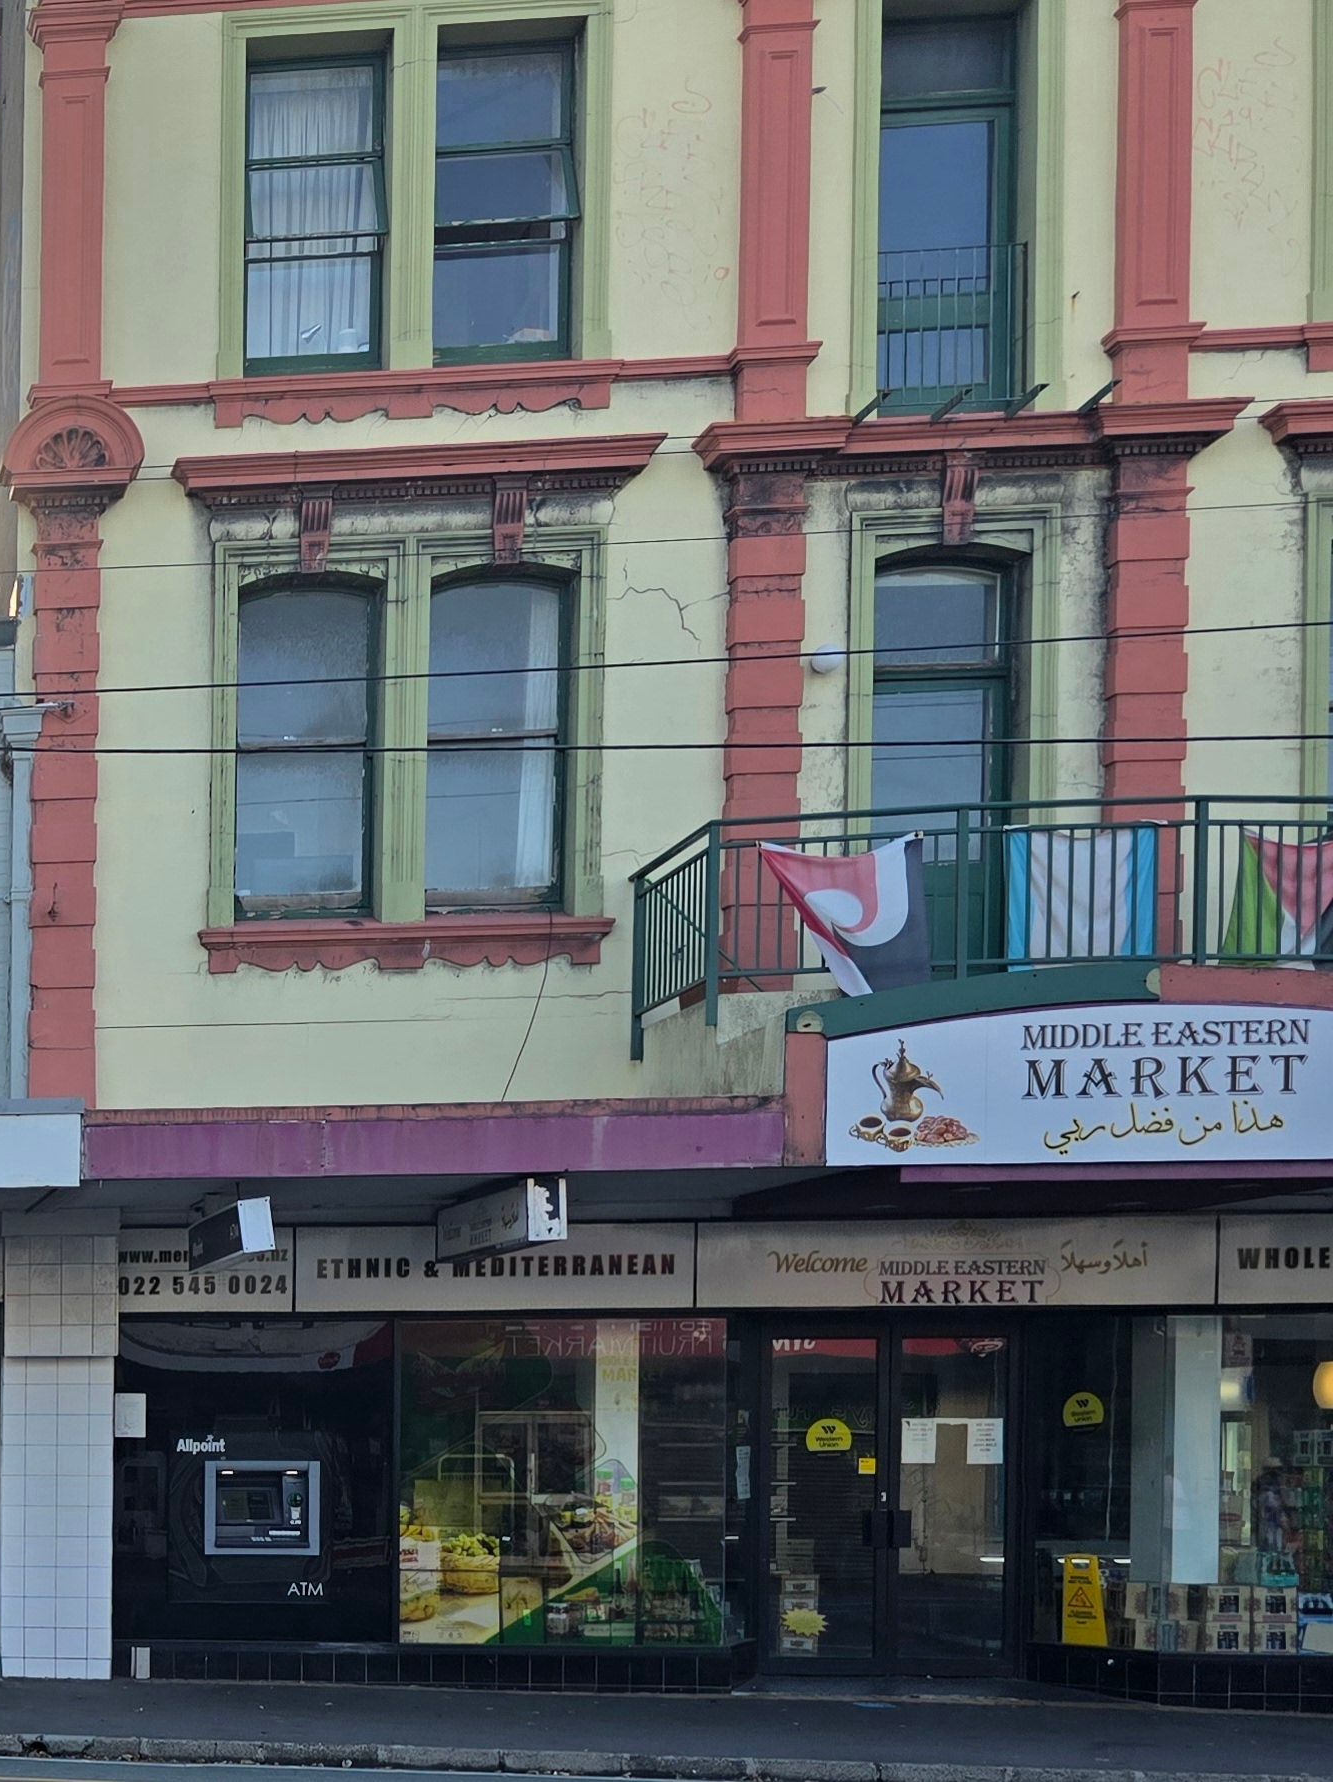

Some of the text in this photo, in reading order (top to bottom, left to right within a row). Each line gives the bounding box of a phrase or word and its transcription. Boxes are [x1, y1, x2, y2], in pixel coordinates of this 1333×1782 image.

[1021, 1019, 1311, 1050] MIDDLE EASTERN
[1021, 1054, 1309, 1100] MARKET
[1043, 1099, 1285, 1156] هذا من فضل ربي
[316, 1254, 676, 1279] ETHNIC & MEDITERRANEAN
[768, 1250, 869, 1273] Welcome
[878, 1259, 1047, 1276] MIDDLE EASTERN
[1237, 1247, 1331, 1270] WHOLE
[118, 1275, 288, 1296] 022 545 0024
[878, 1280, 1045, 1304] MARKET
[176, 1435, 226, 1455] Allpoint
[287, 1582, 324, 1597] ATM
